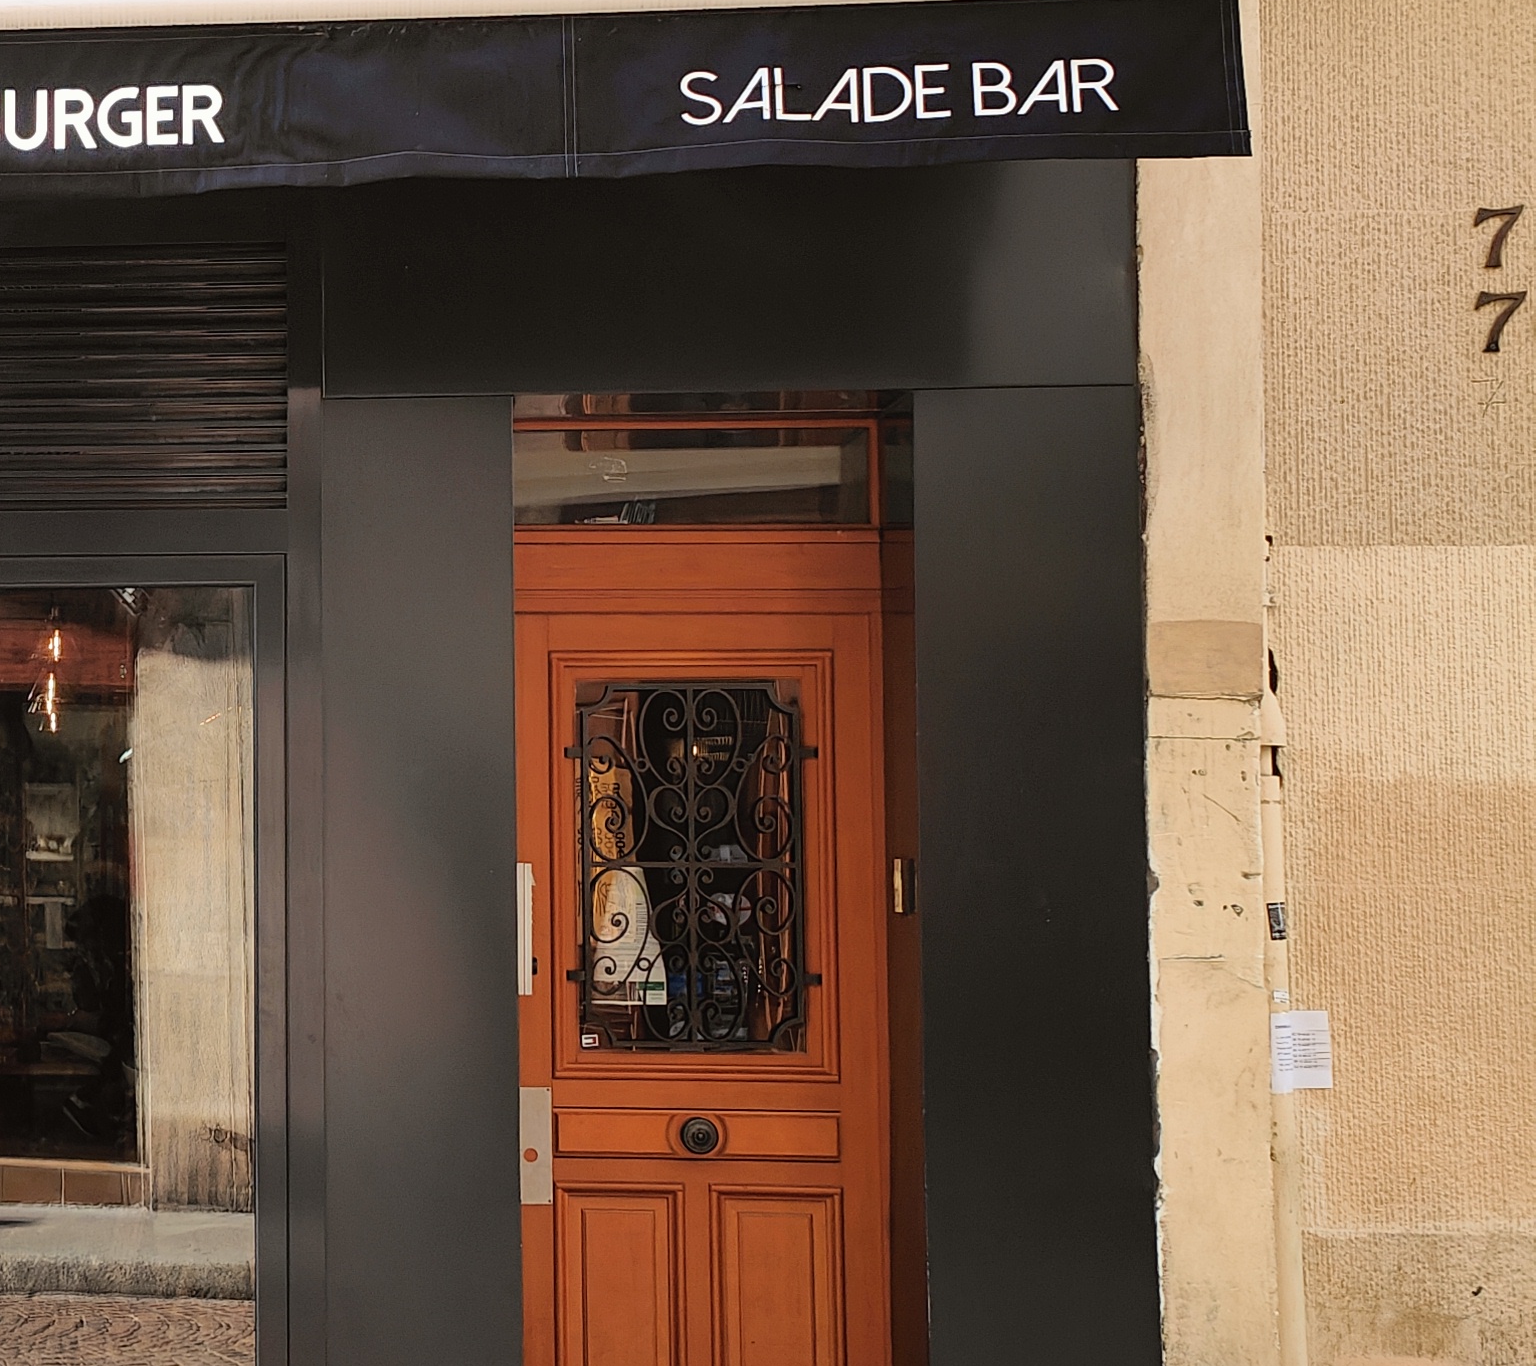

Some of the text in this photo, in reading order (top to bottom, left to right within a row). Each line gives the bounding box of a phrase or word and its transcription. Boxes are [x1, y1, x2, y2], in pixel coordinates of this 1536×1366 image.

[680, 58, 1119, 125] SALADE BAR
[1474, 204, 1524, 268] 7
[1474, 291, 1527, 353] 7
